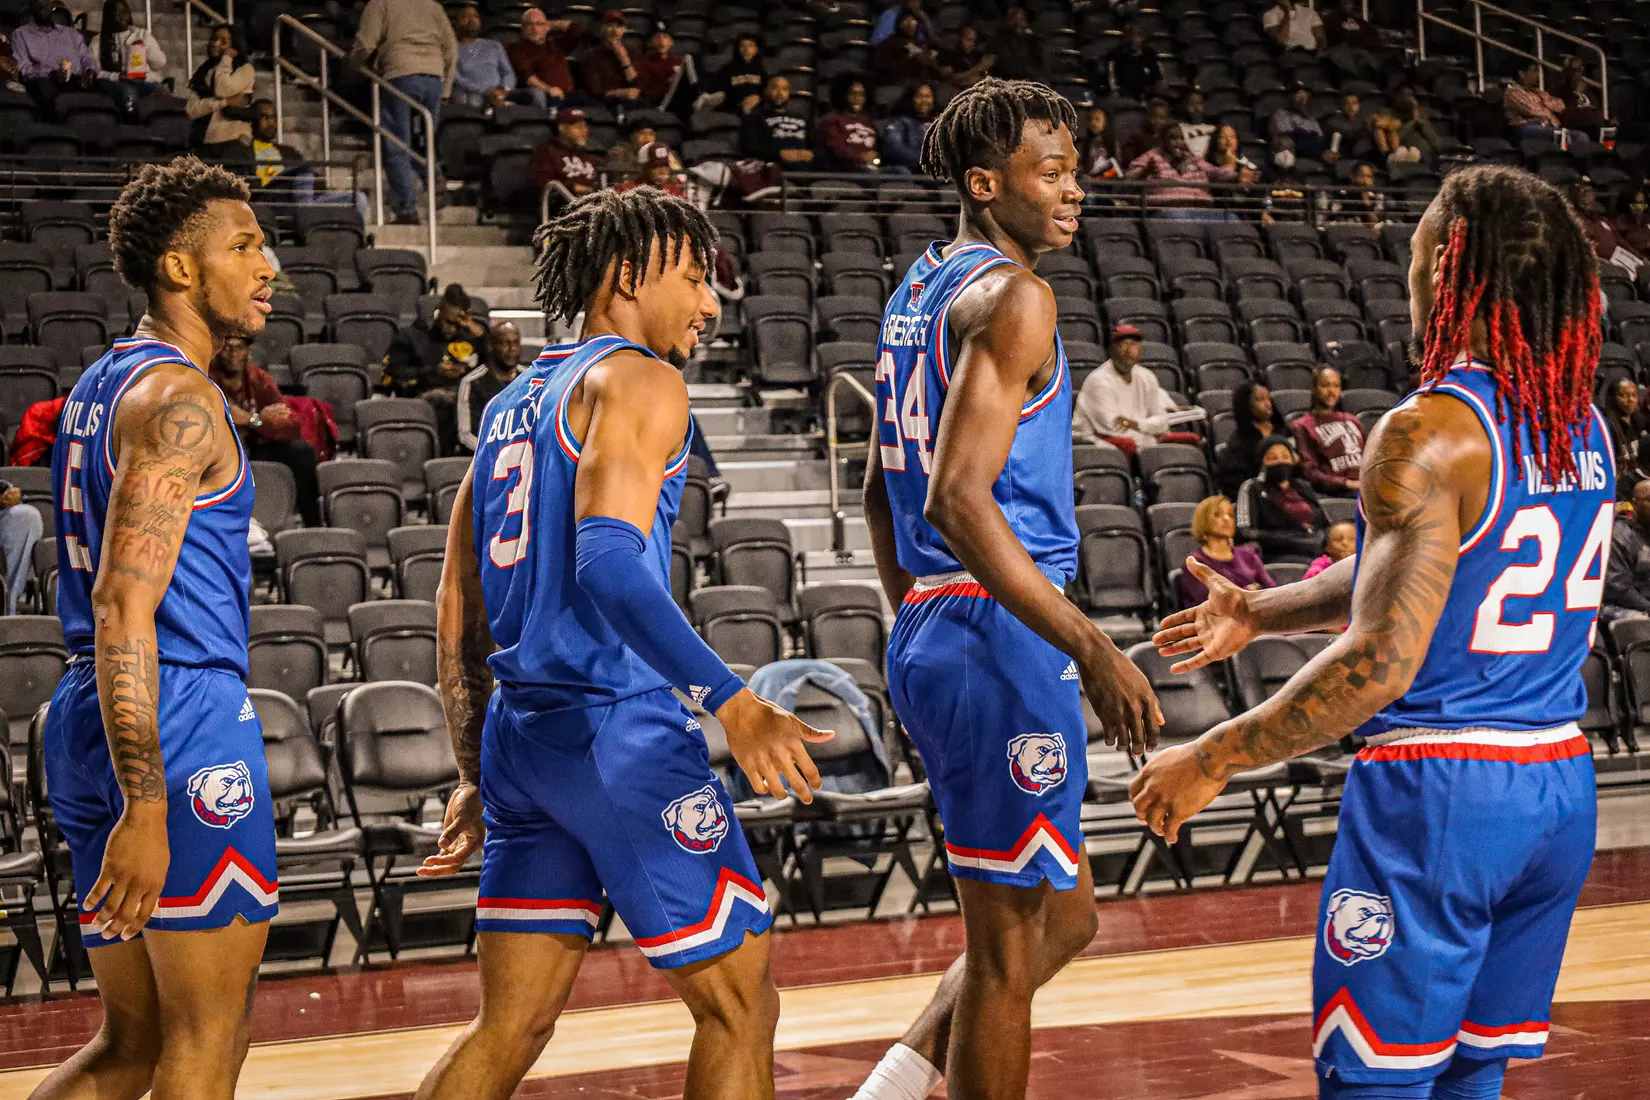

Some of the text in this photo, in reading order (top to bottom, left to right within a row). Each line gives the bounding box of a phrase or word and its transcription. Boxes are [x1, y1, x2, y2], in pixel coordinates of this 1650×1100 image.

[875, 350, 935, 476] 34
[1523, 450, 1607, 495] WIAMS
[489, 438, 535, 570] 3
[1468, 500, 1616, 656] 24
